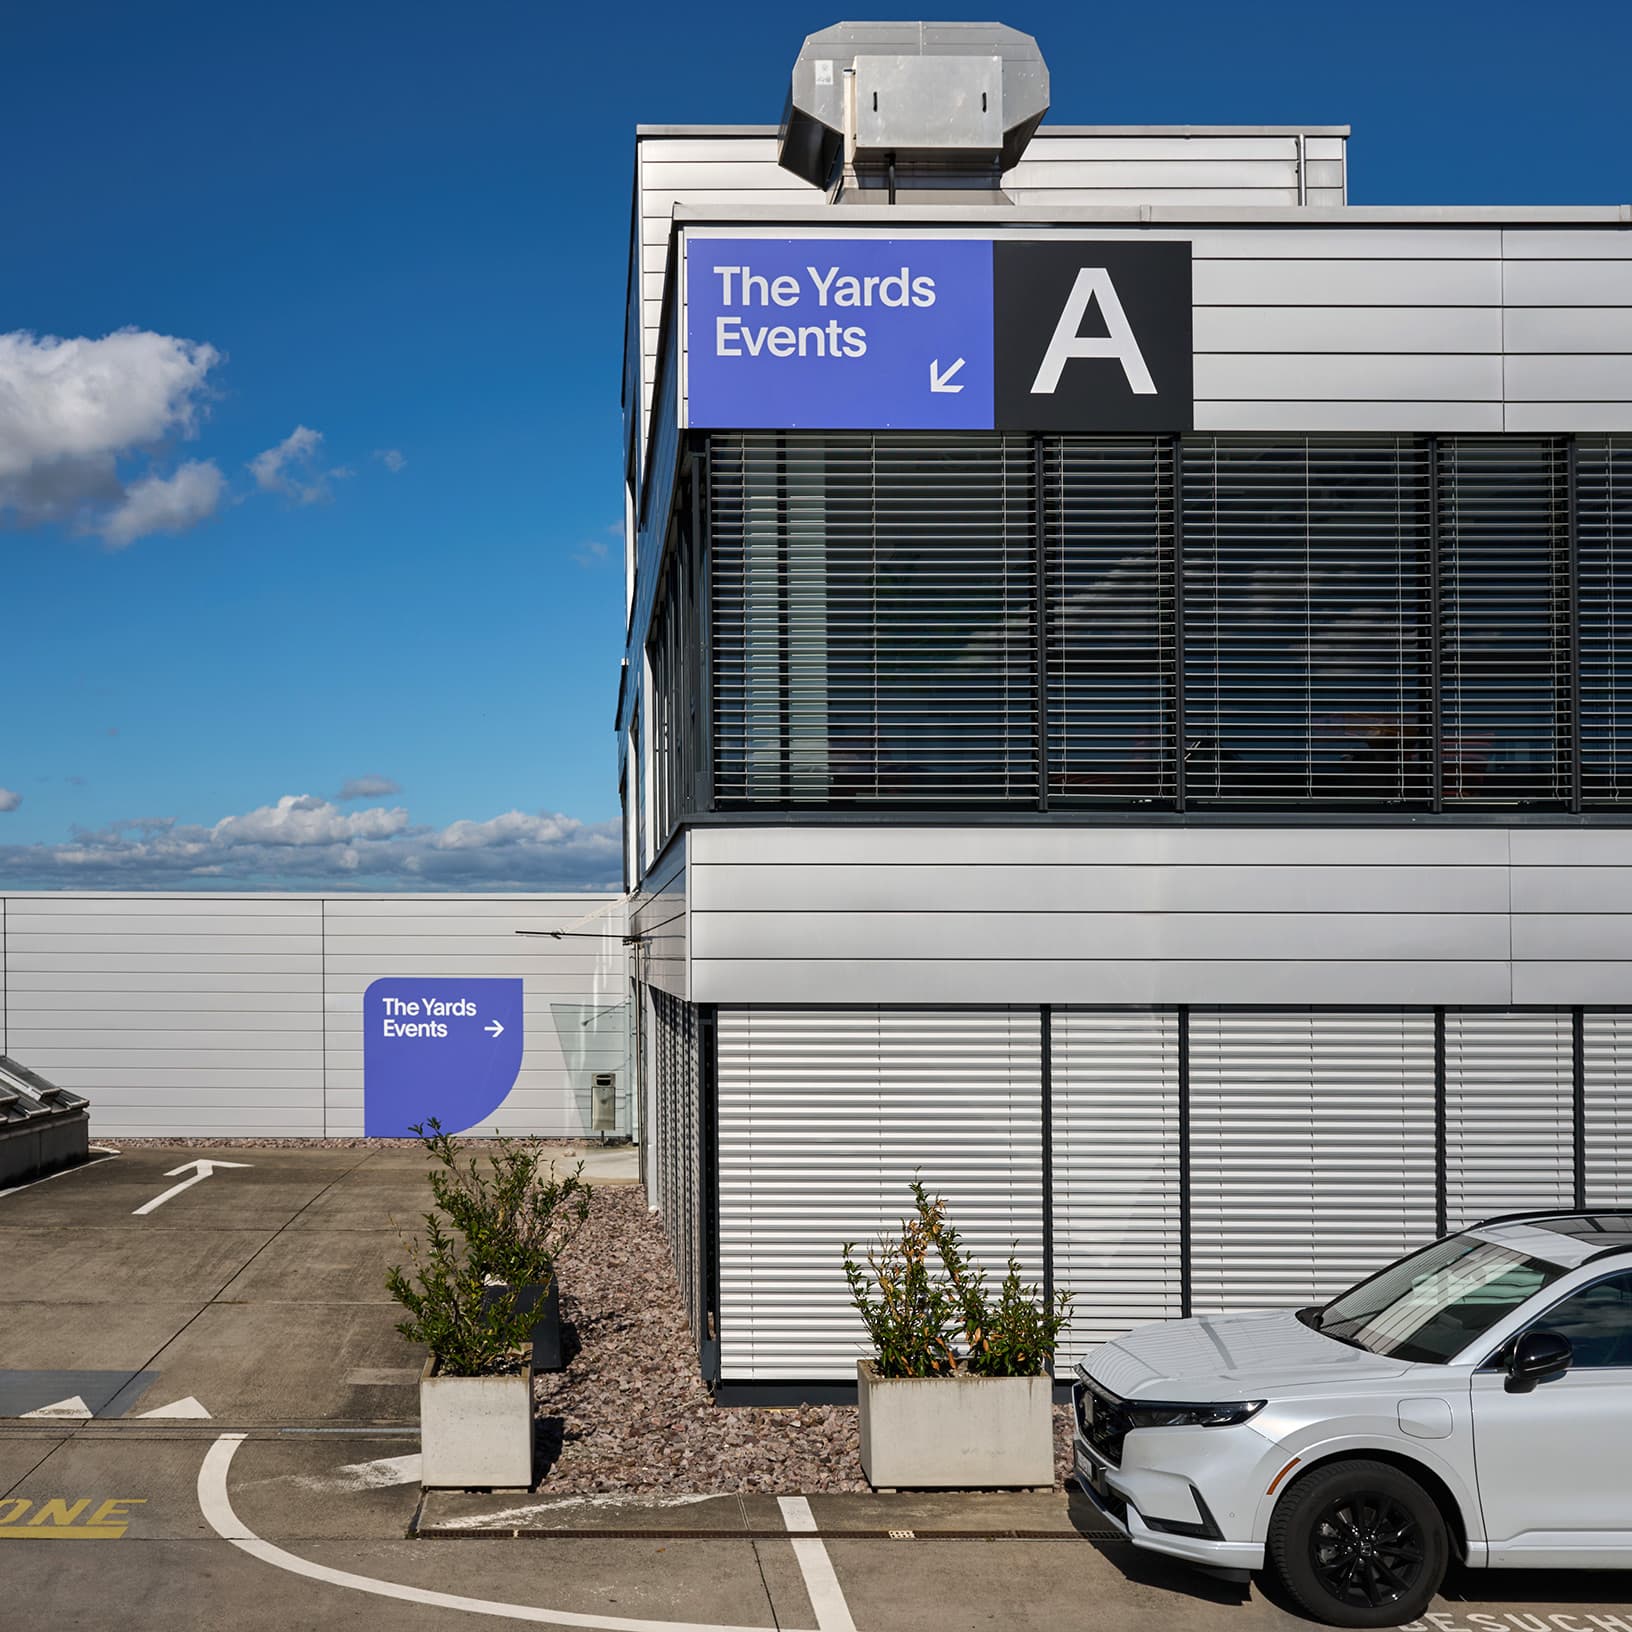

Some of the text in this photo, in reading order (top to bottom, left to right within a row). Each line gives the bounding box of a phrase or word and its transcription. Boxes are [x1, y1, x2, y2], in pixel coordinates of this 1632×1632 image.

[713, 266, 936, 308] The Yards
[715, 316, 867, 358] Events
[1030, 267, 1158, 395] A
[382, 997, 478, 1017] The Yards
[383, 1019, 448, 1039] Events
[1398, 1612, 1632, 1632] ESUCH
